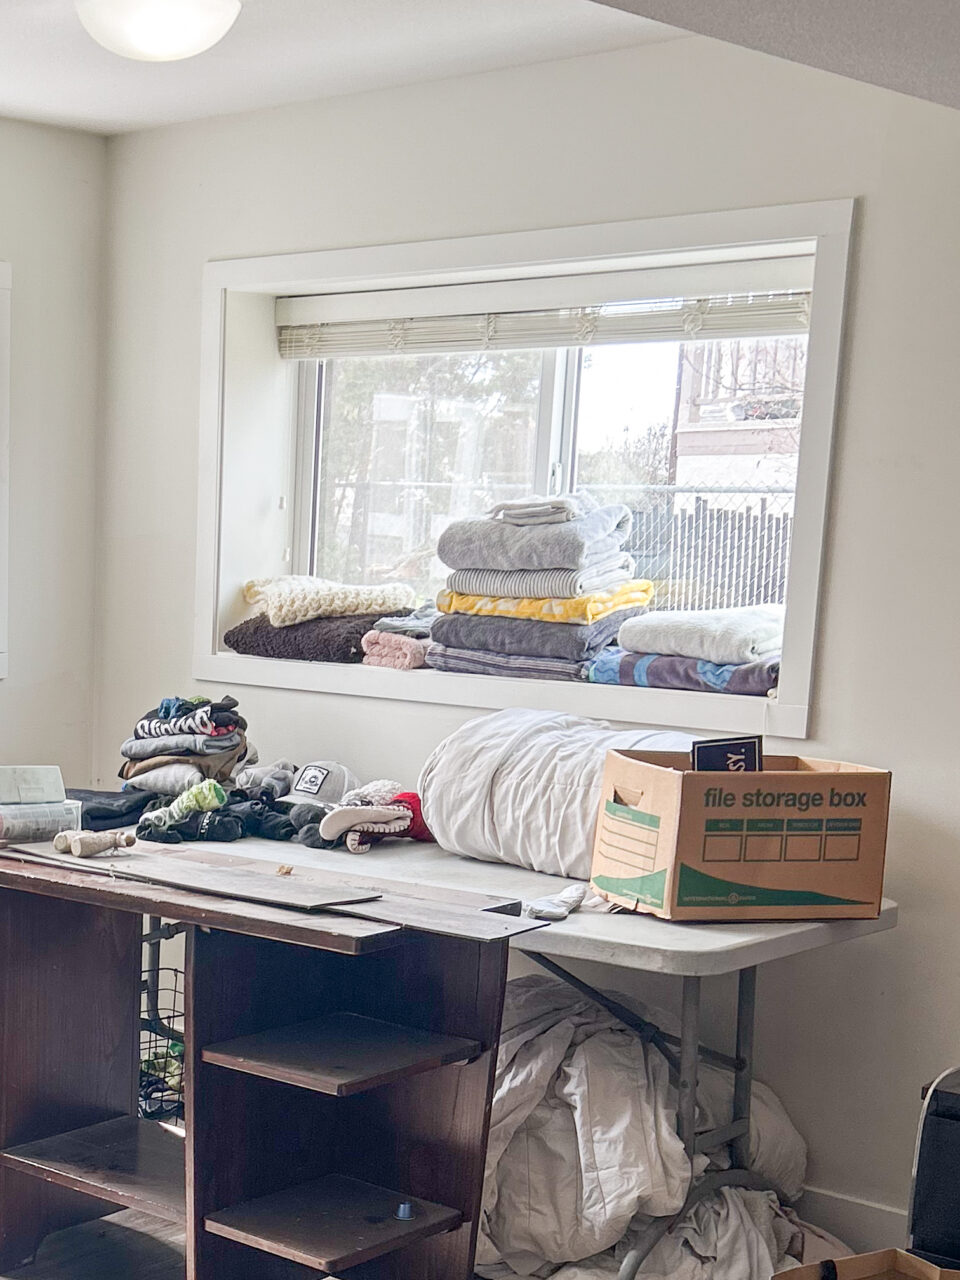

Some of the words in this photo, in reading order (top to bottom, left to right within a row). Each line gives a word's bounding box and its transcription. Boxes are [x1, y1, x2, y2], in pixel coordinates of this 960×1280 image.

[703, 787, 736, 808] file
[741, 788, 824, 812] storage
[828, 787, 867, 808] box
